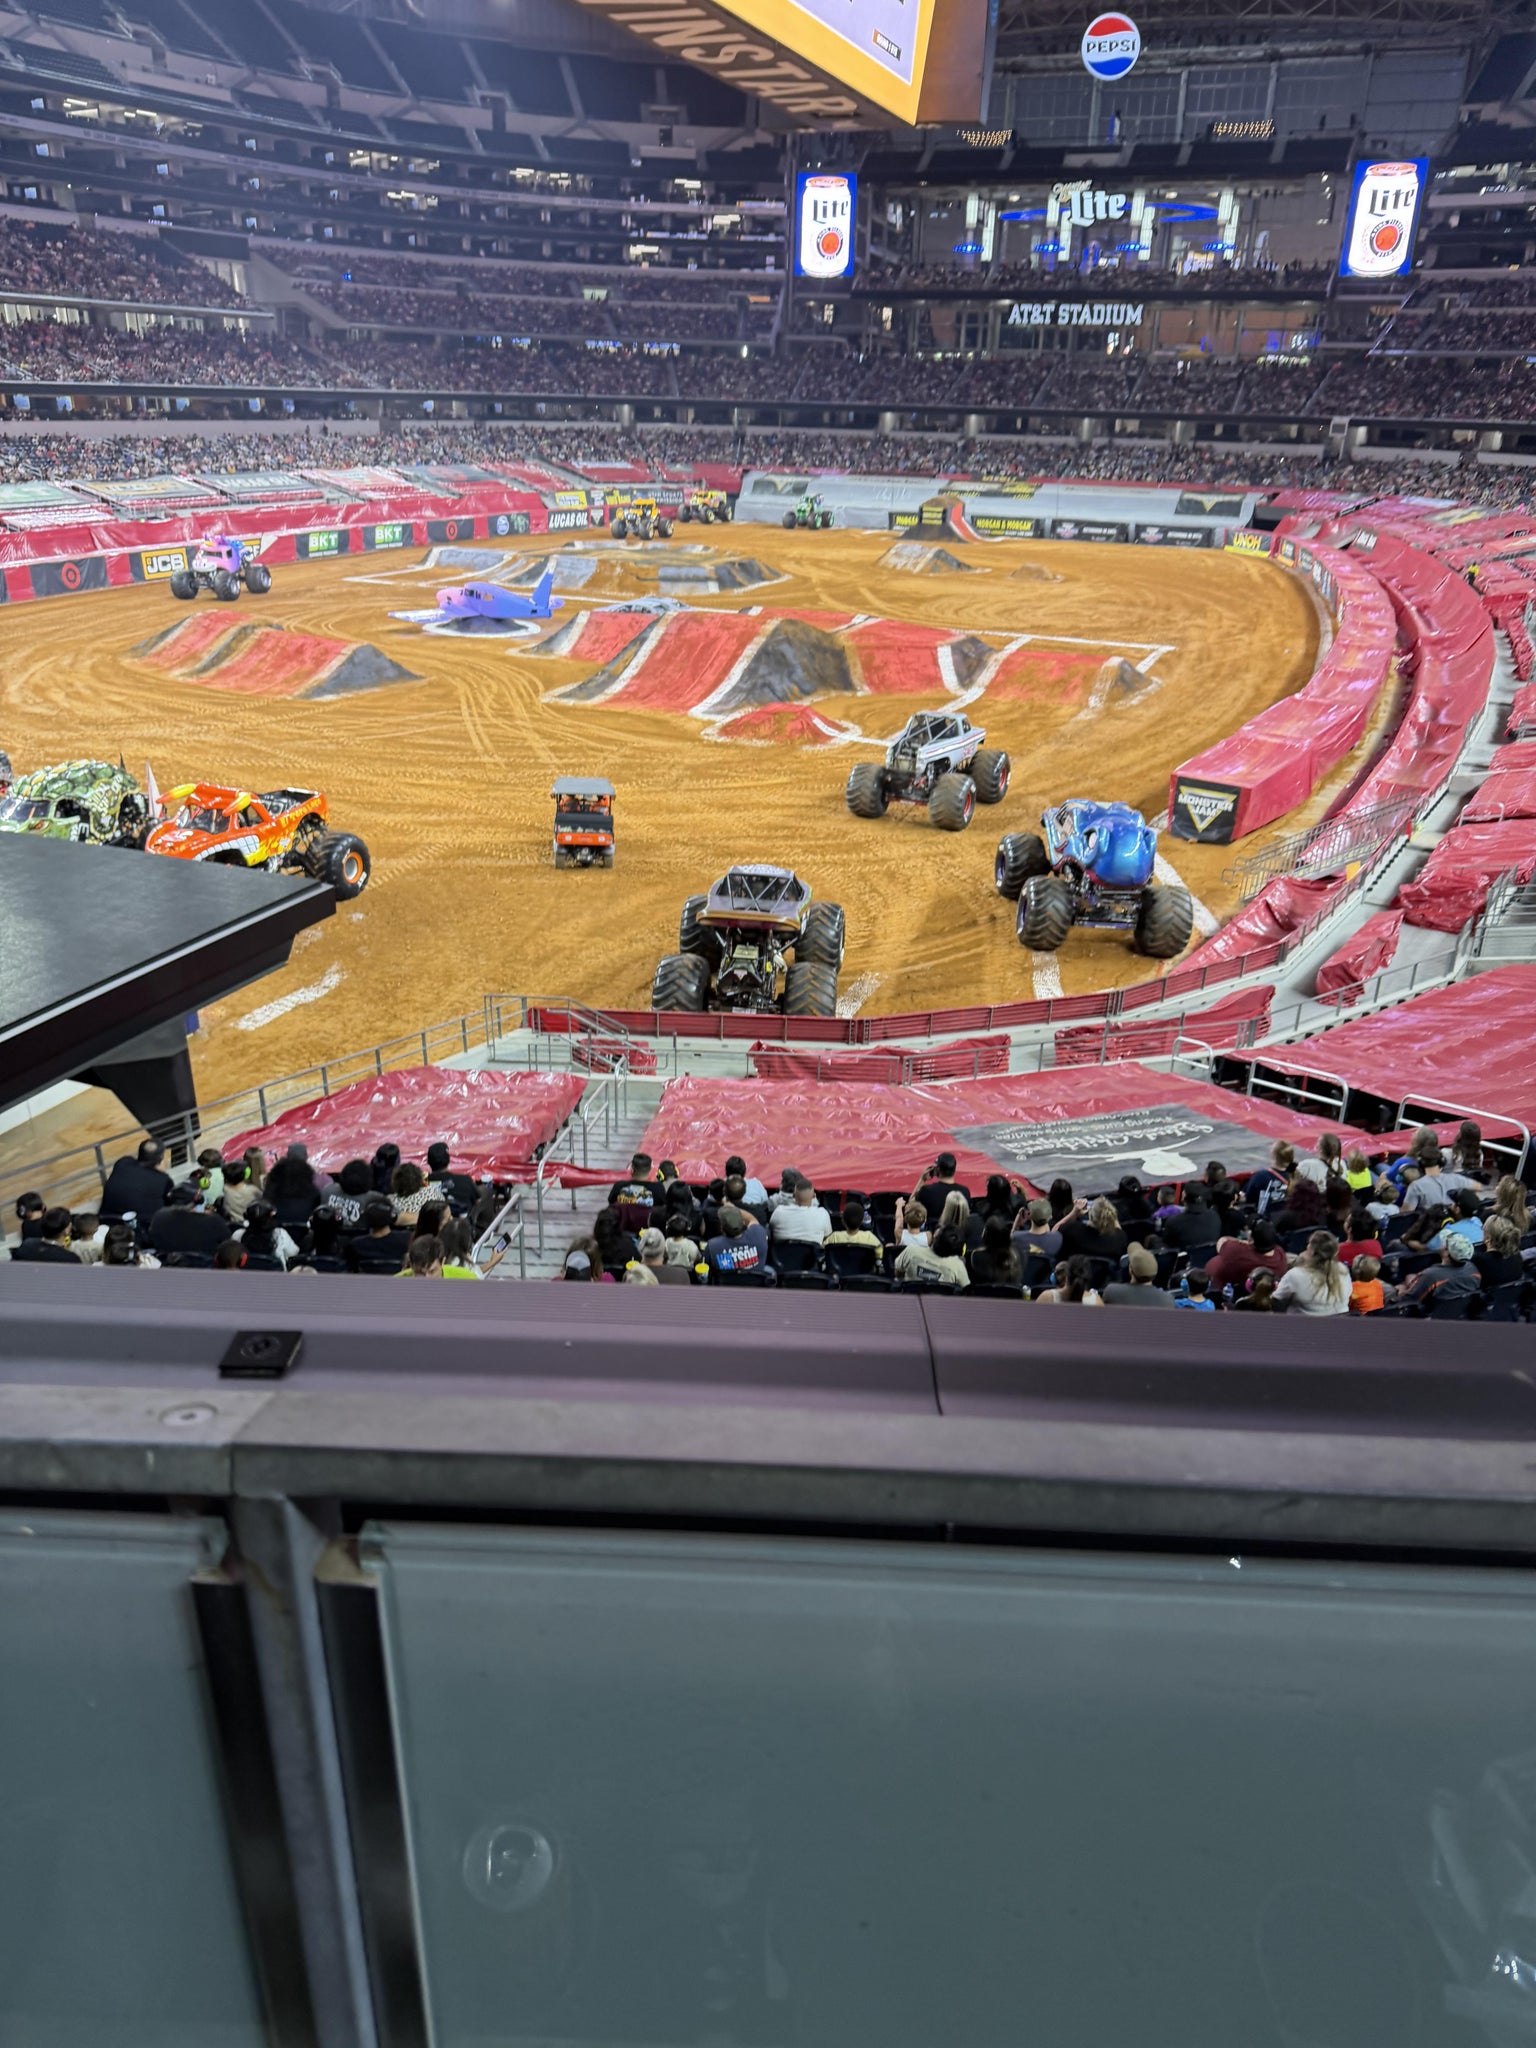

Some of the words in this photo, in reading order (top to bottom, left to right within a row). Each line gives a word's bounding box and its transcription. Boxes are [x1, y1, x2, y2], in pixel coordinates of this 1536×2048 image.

[1086, 39, 1136, 53] PEPSI
[578, 0, 858, 118] INSTAR
[1068, 190, 1126, 227] Lite
[1368, 189, 1415, 217] Lite
[1008, 303, 1055, 325] AT&T
[1057, 303, 1144, 325] STADIUM
[549, 512, 576, 529] LUCAS
[576, 511, 588, 526] OIL
[309, 533, 338, 549] BKT
[376, 527, 402, 540] BKT
[1233, 531, 1262, 550] UNOH
[146, 553, 184, 573] JCB
[1178, 793, 1233, 812] MONSTER
[1195, 805, 1217, 817] JAM
